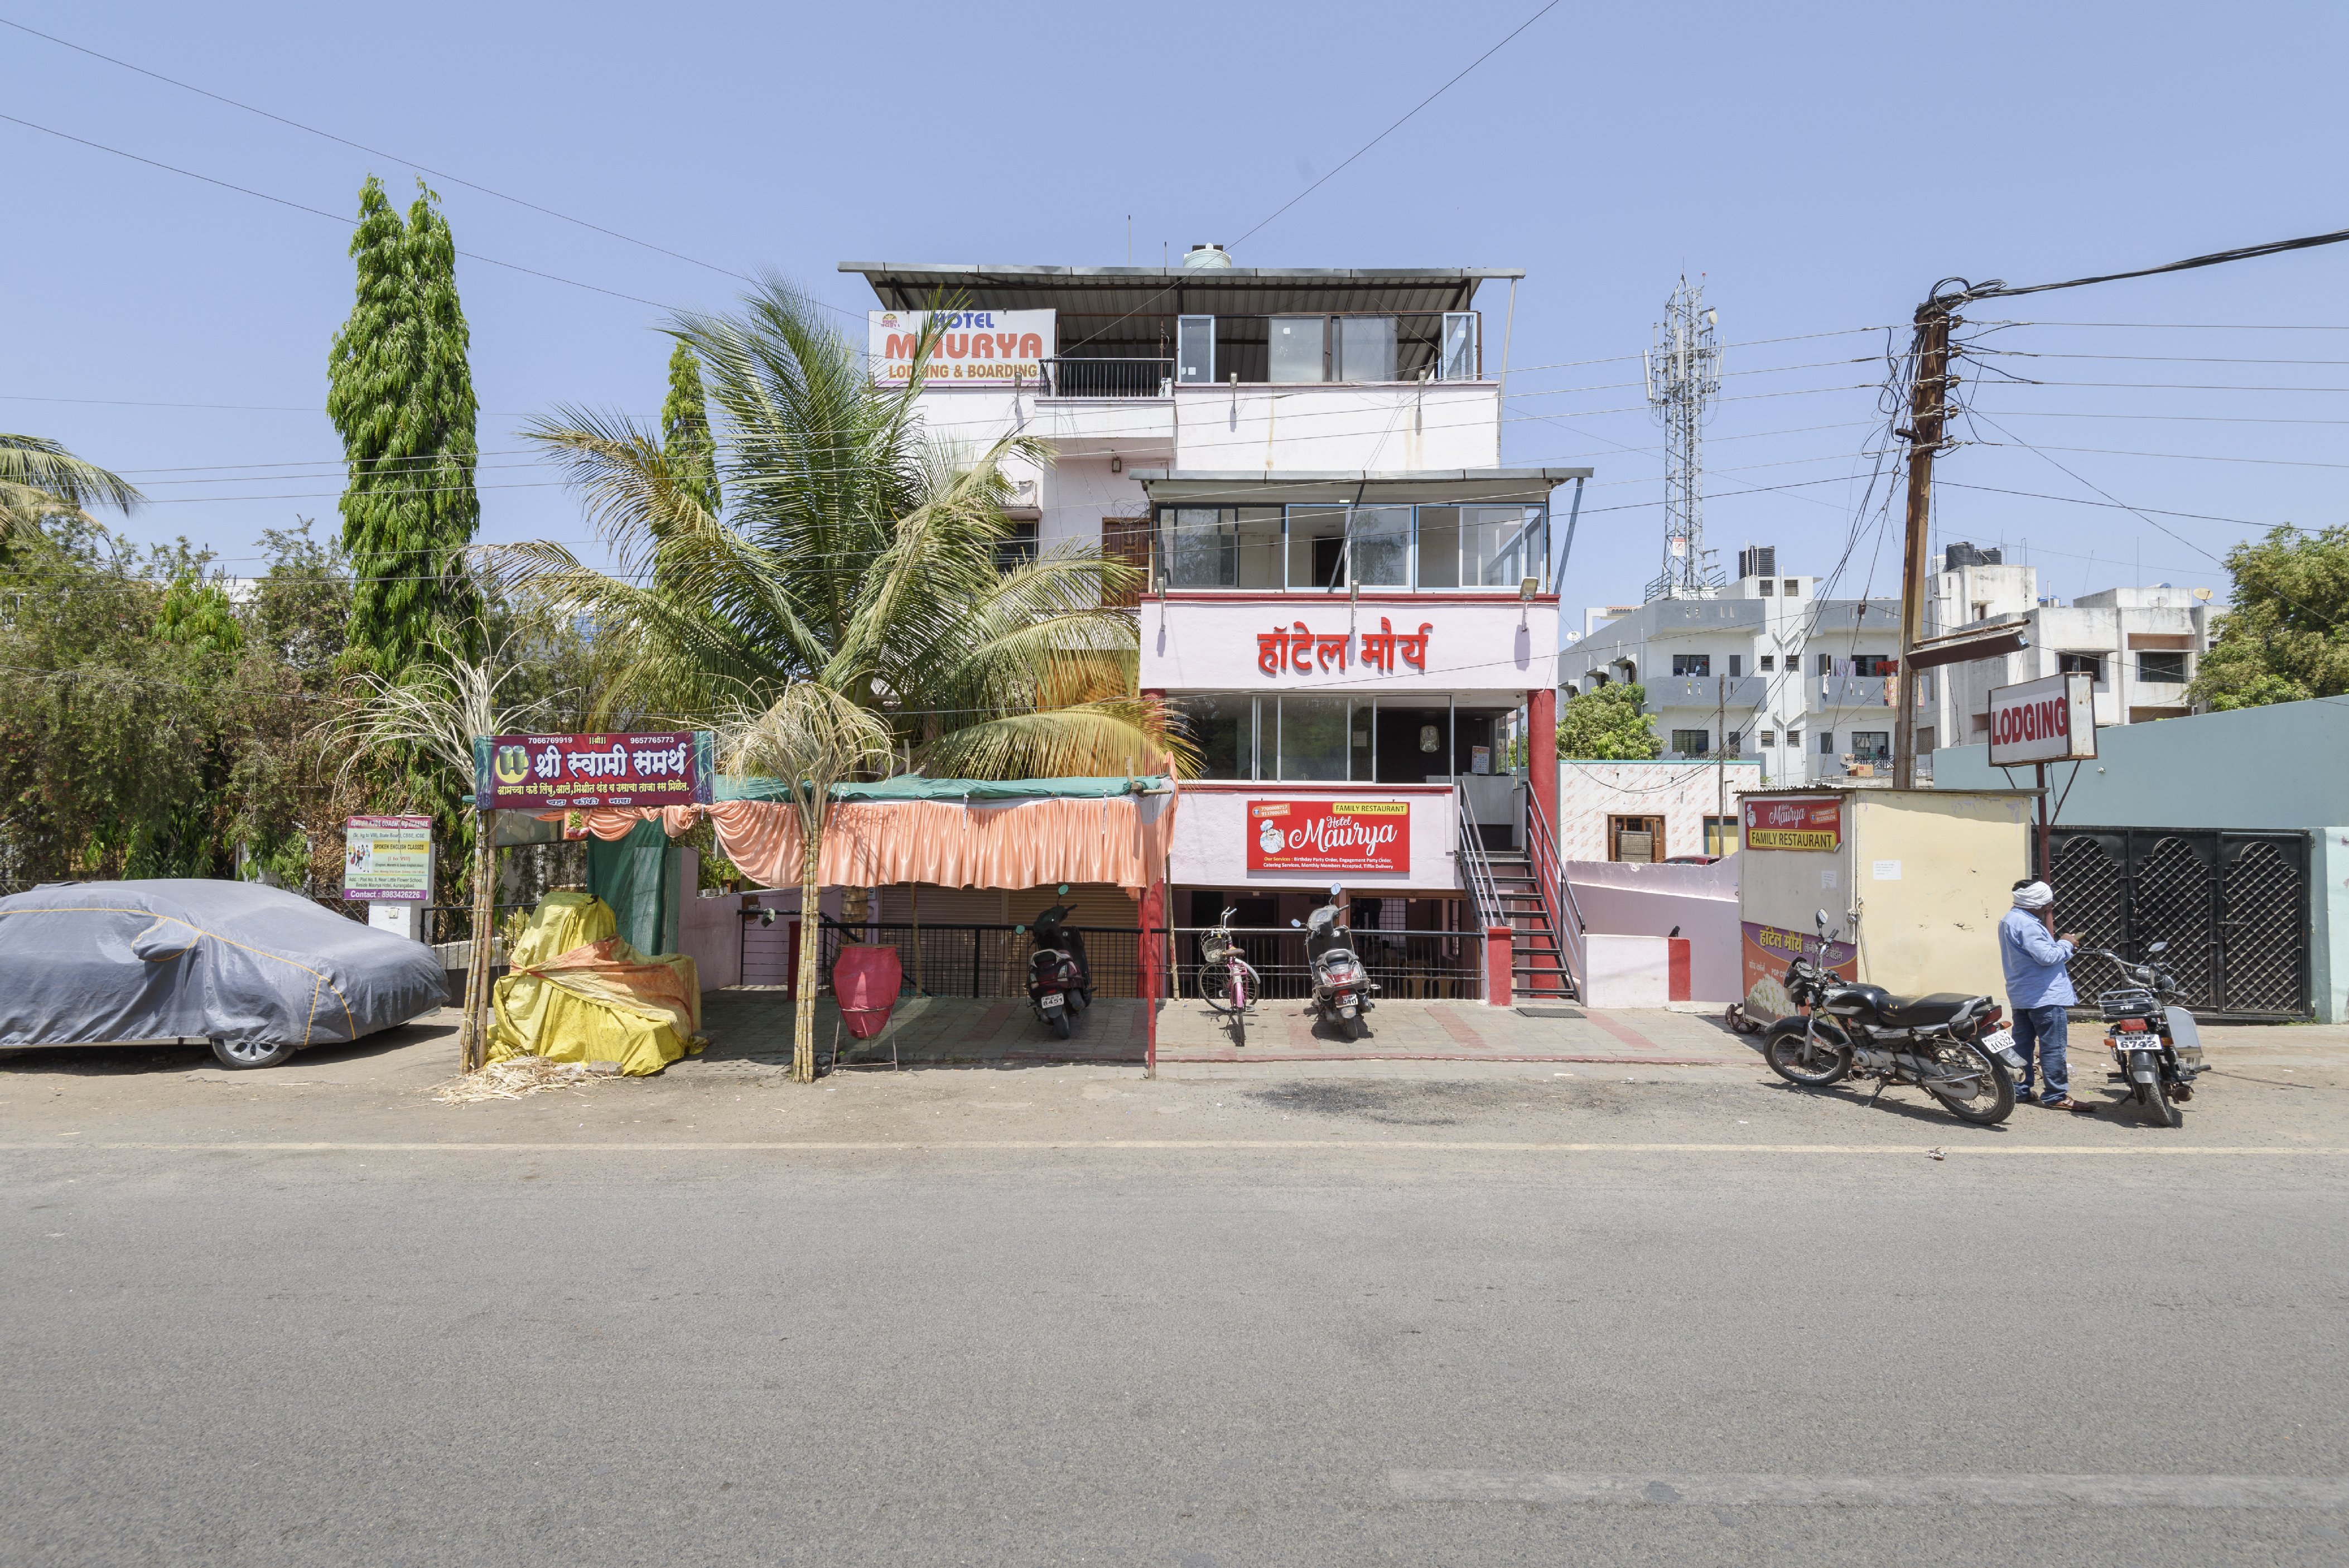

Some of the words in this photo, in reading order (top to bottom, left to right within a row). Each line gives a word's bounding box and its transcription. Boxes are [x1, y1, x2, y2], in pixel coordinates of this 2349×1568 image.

[933, 313, 995, 329] HOTEL
[889, 365, 949, 378] LODING
[954, 365, 963, 378] &
[968, 365, 1038, 378] BOARDING
[1257, 621, 1349, 674] हॉटेल
[1361, 616, 1433, 670] मौर्य
[1992, 697, 2068, 746] LODGING
[534, 744, 562, 778] श्री
[567, 743, 628, 778] स्वामी
[633, 742, 687, 777] समर्थ
[498, 785, 524, 795] आमच्या
[525, 783, 538, 795] कडे
[596, 781, 607, 793] थंड
[609, 784, 615, 793] व
[616, 783, 637, 793] उसाचा
[639, 783, 655, 793] ताजा
[657, 783, 667, 792] रस
[1326, 816, 1352, 828] Hotel
[1769, 805, 1806, 828] Maurya
[1289, 818, 1397, 856] Maurya
[1752, 832, 1777, 845] FAMILY
[1779, 833, 1832, 847] RESTAURANT
[1043, 997, 1063, 1006] 8451
[1991, 1036, 2013, 1050] 4032
